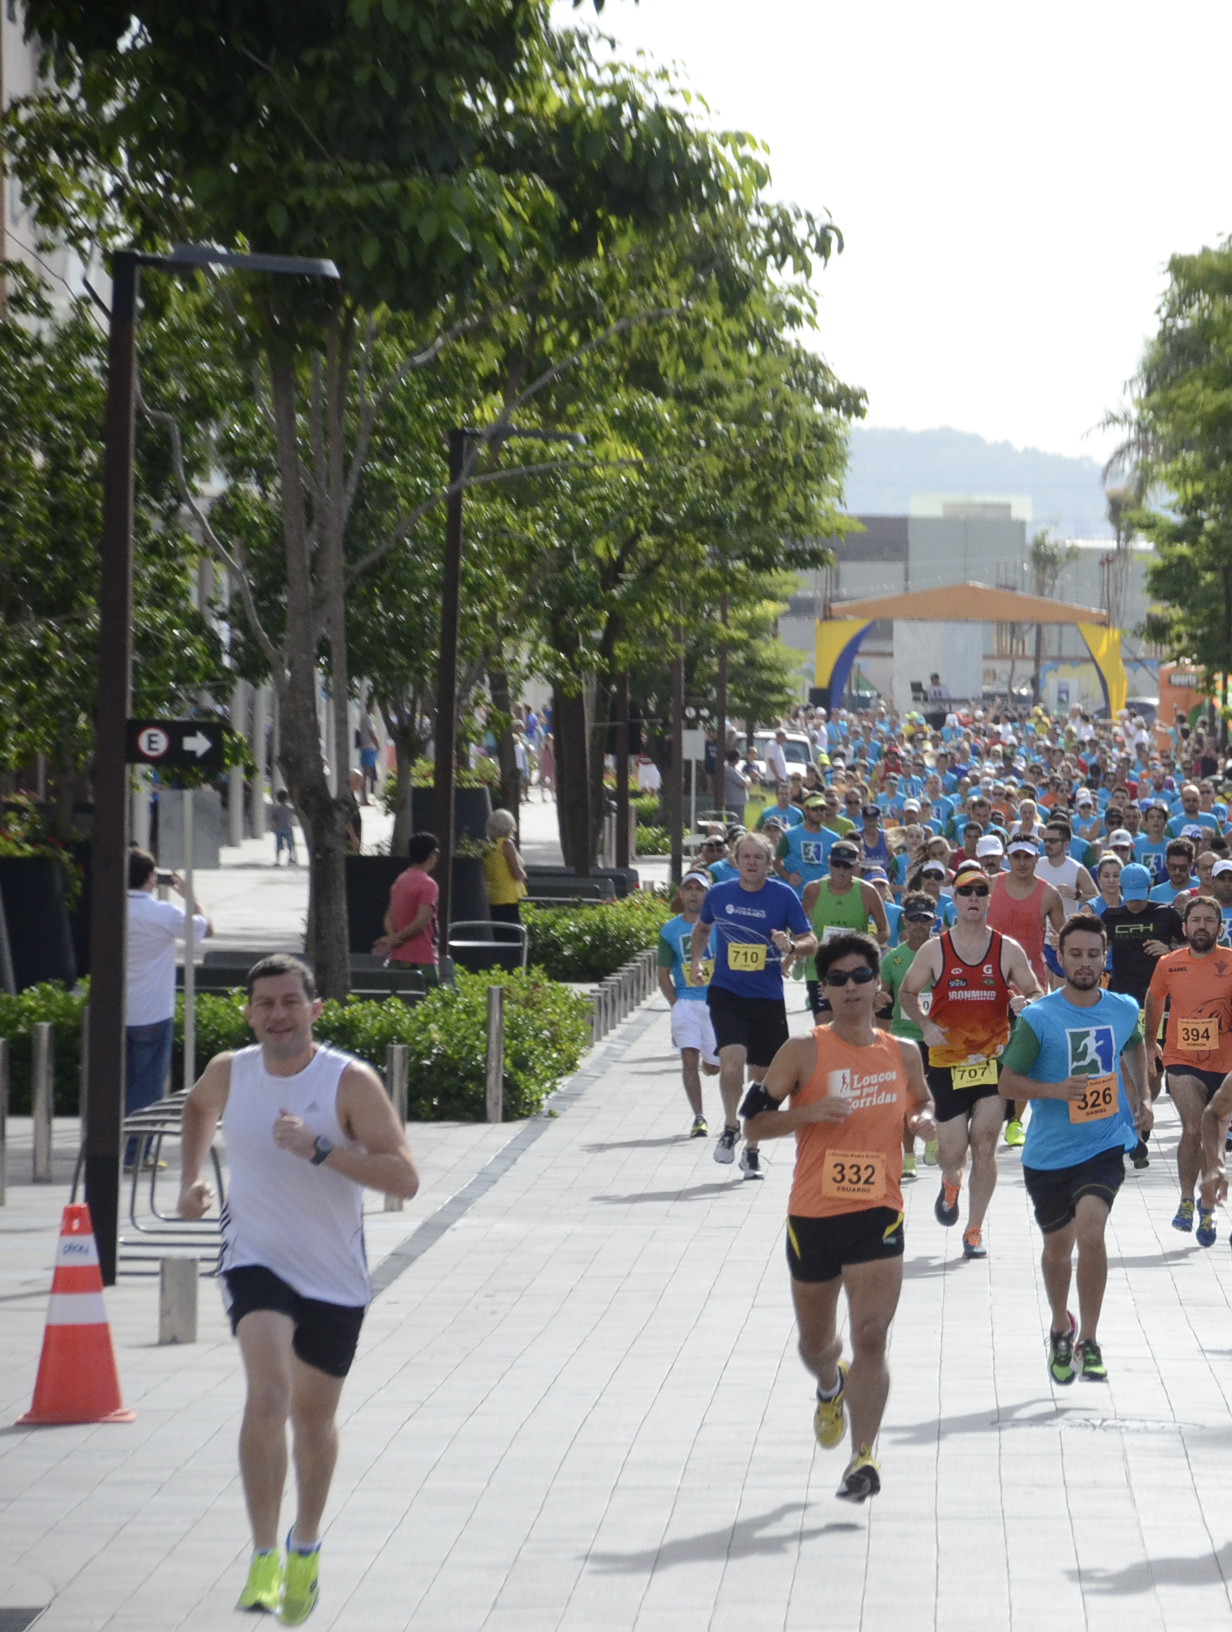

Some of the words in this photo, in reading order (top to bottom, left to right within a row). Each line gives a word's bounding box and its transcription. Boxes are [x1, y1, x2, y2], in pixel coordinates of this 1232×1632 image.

[147, 733, 159, 752] E
[732, 950, 759, 964] 710
[1182, 1027, 1211, 1042] 394
[853, 1070, 897, 1089] Loucos
[957, 1066, 988, 1080] 707
[862, 1084, 878, 1097] por
[1077, 1086, 1113, 1111] 326
[831, 1162, 876, 1186] 332
[836, 1186, 871, 1194] EDUARDO
